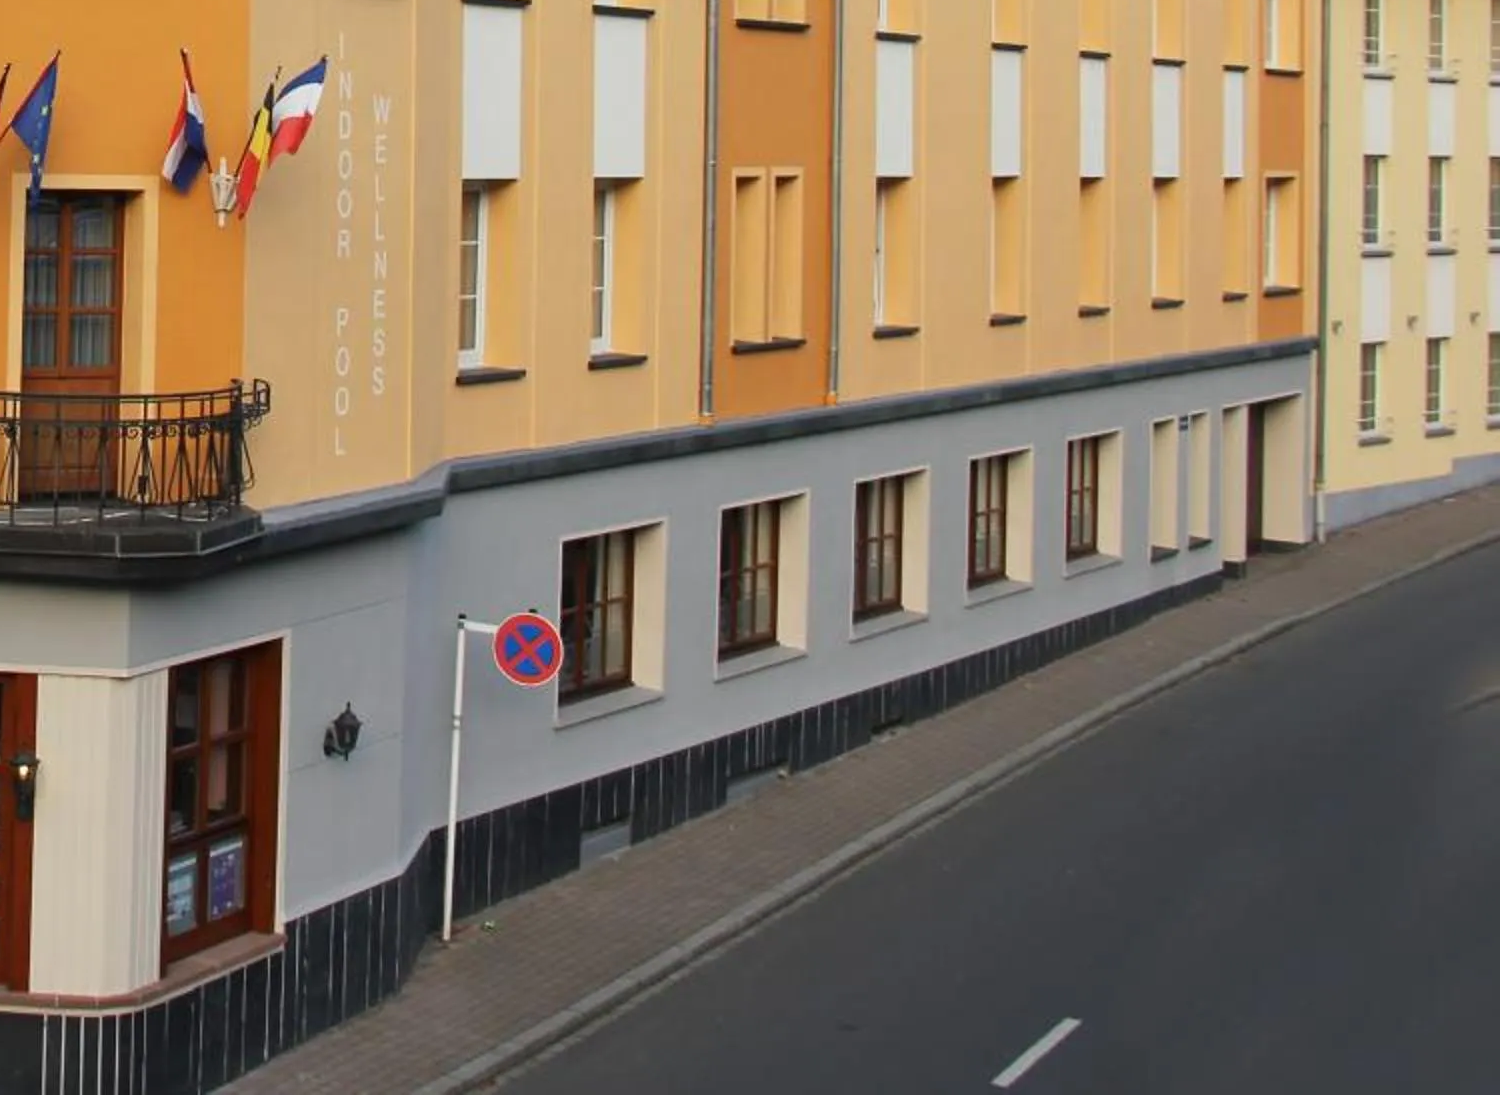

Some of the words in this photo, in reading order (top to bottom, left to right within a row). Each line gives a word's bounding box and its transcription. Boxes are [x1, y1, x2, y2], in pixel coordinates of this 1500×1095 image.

[337, 31, 353, 259] INDOOR
[371, 93, 392, 396] WELLNESS
[334, 307, 350, 456] POOL
